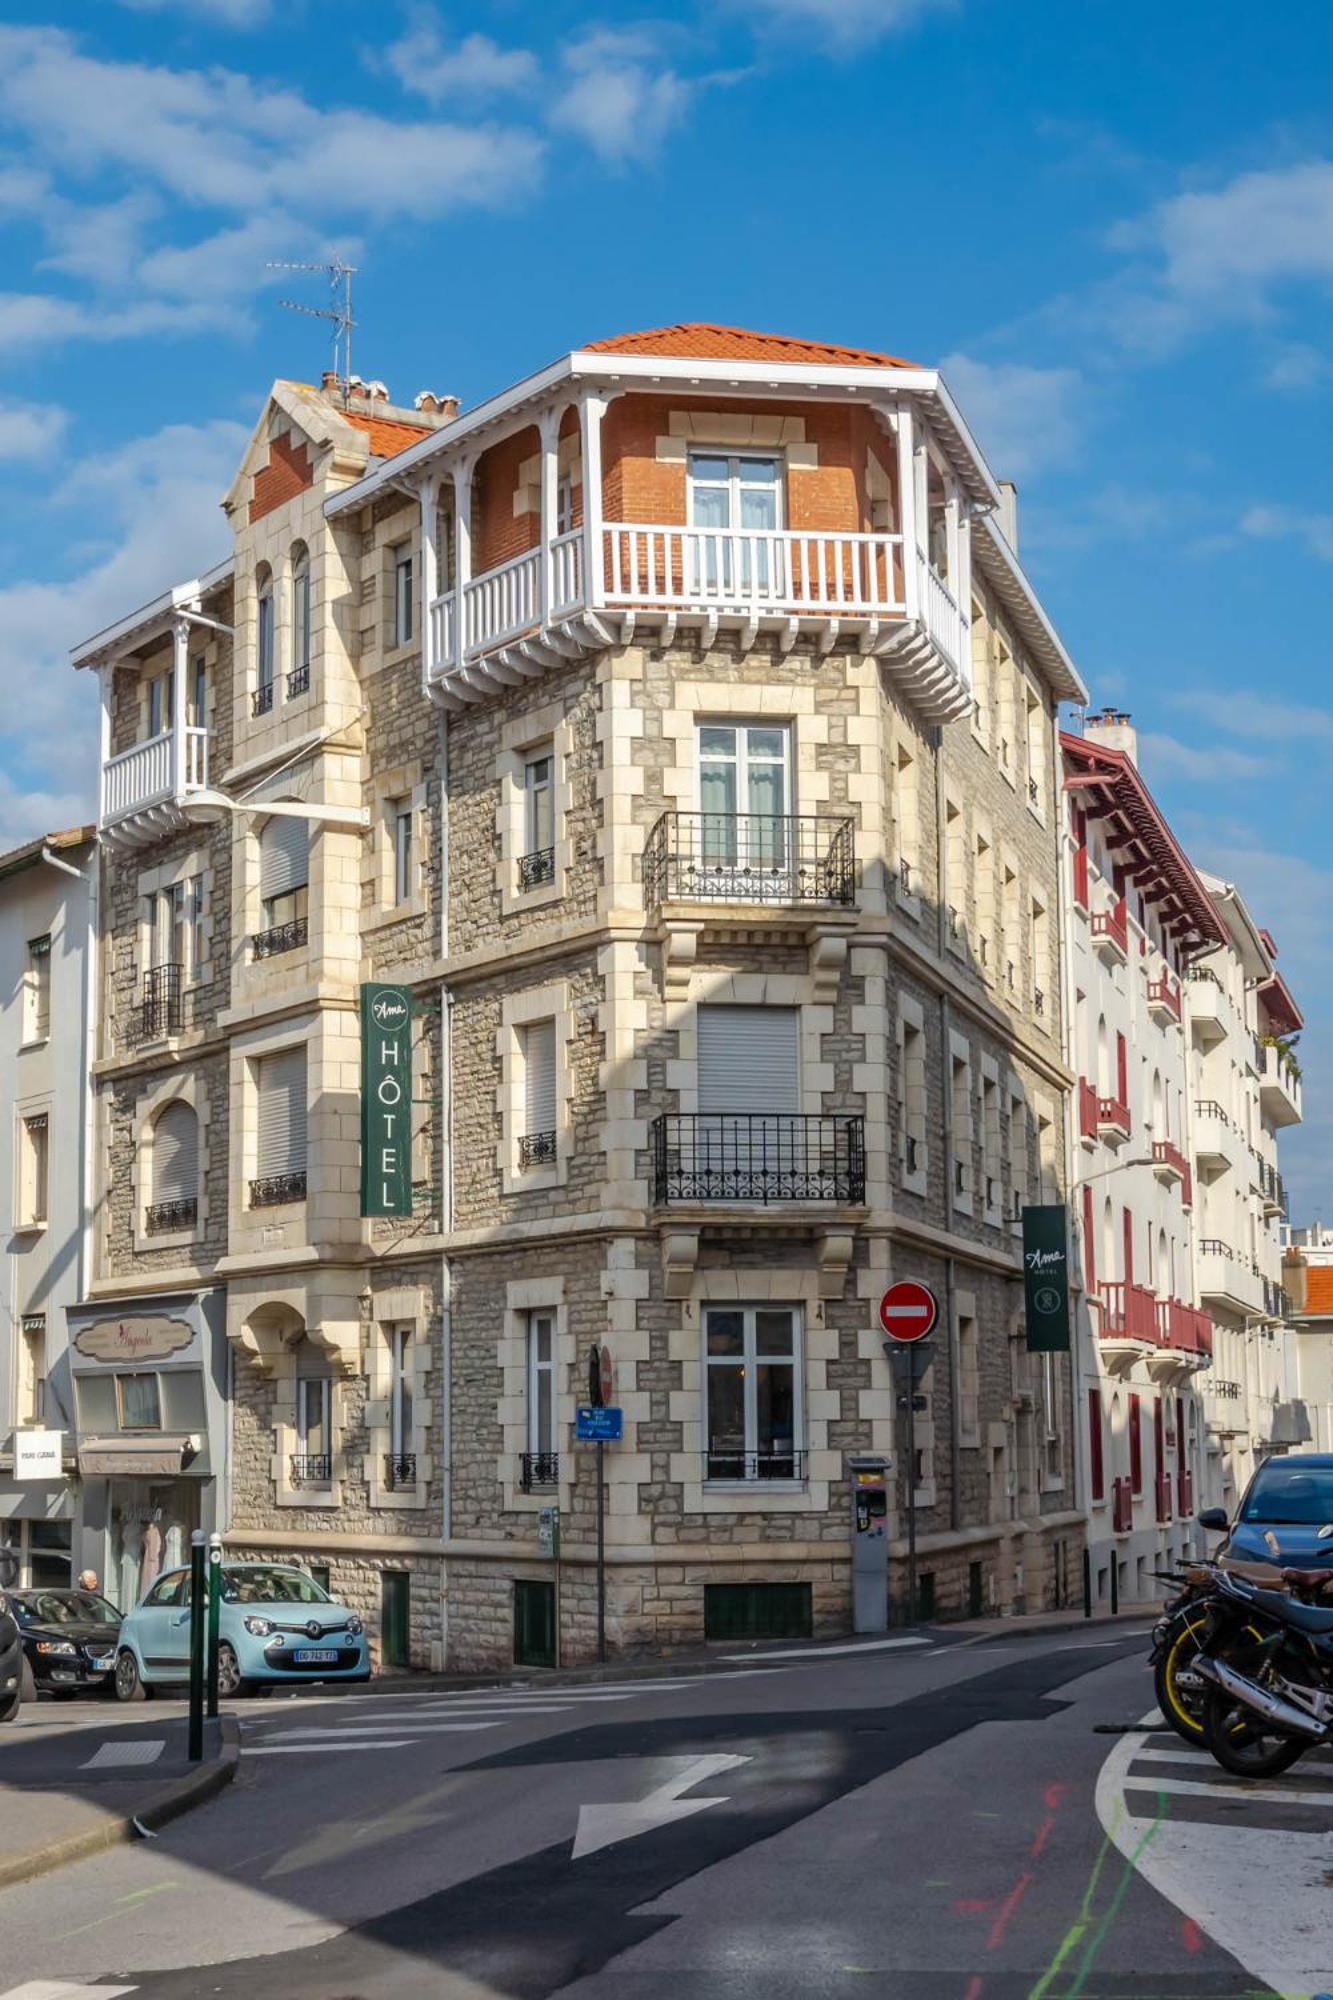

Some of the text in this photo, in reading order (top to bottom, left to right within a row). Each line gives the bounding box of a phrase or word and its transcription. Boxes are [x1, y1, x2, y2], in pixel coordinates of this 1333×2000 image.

[374, 1002, 406, 1018] Ama
[378, 1041, 401, 1207] HÔTEL
[1025, 1248, 1065, 1269] Ama
